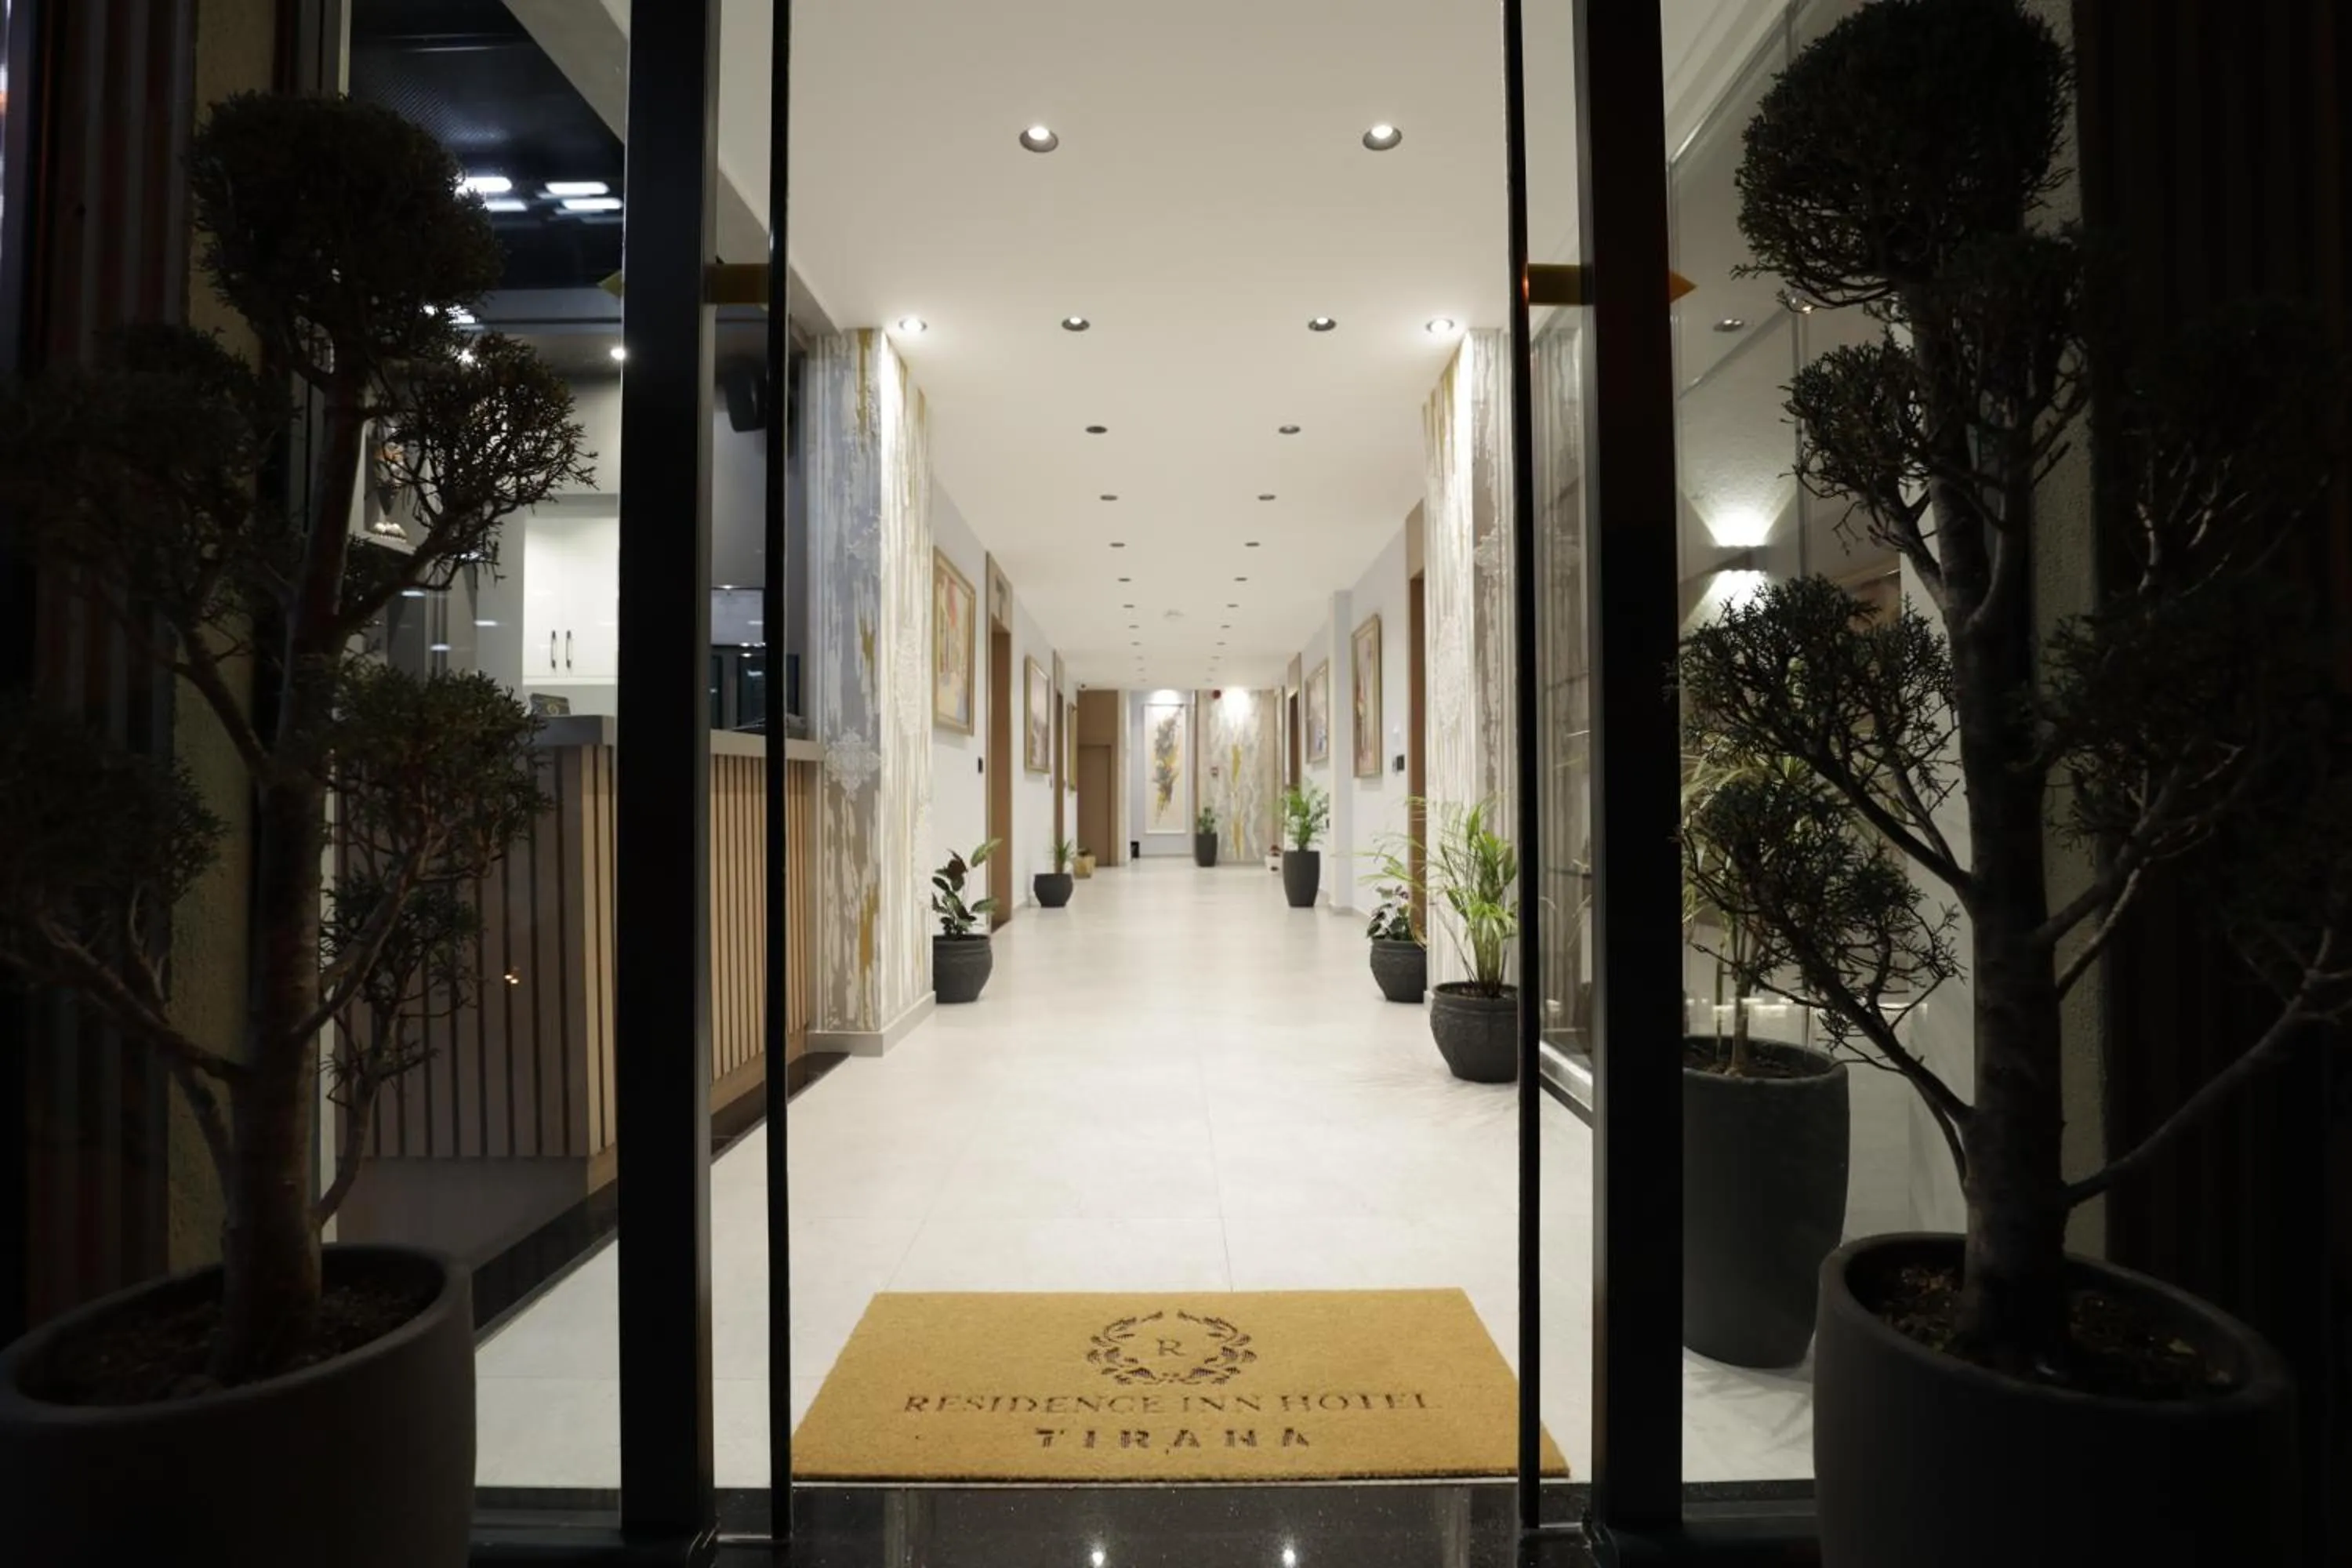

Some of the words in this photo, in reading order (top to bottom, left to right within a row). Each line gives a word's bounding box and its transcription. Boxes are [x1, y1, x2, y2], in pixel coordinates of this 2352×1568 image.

[1156, 1338, 1186, 1357] R
[904, 1396, 1165, 1413] RESIDENCE
[1180, 1396, 1262, 1413] INN
[1278, 1393, 1436, 1412] HOTEL
[1035, 1427, 1311, 1449] TIRANA
